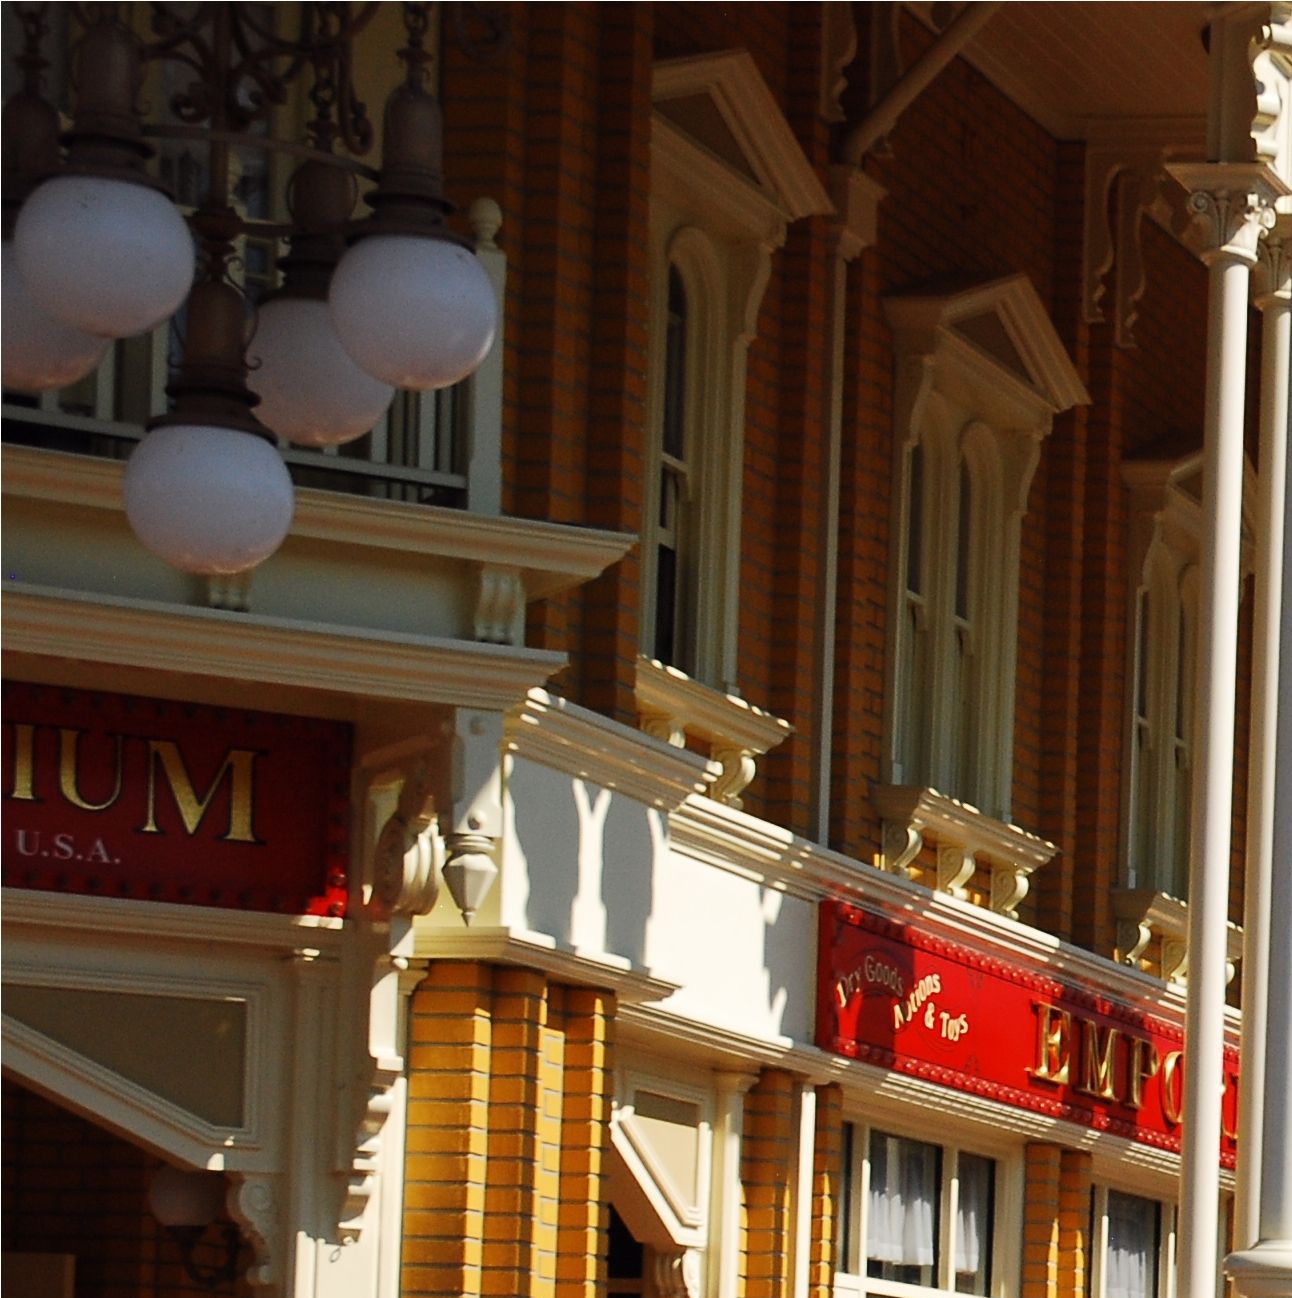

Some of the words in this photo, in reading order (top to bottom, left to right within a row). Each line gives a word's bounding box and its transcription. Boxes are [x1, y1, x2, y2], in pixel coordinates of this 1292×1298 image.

[10, 724, 270, 845] IUM
[16, 829, 121, 865] U.S.A.
[924, 1002, 935, 1030] &
